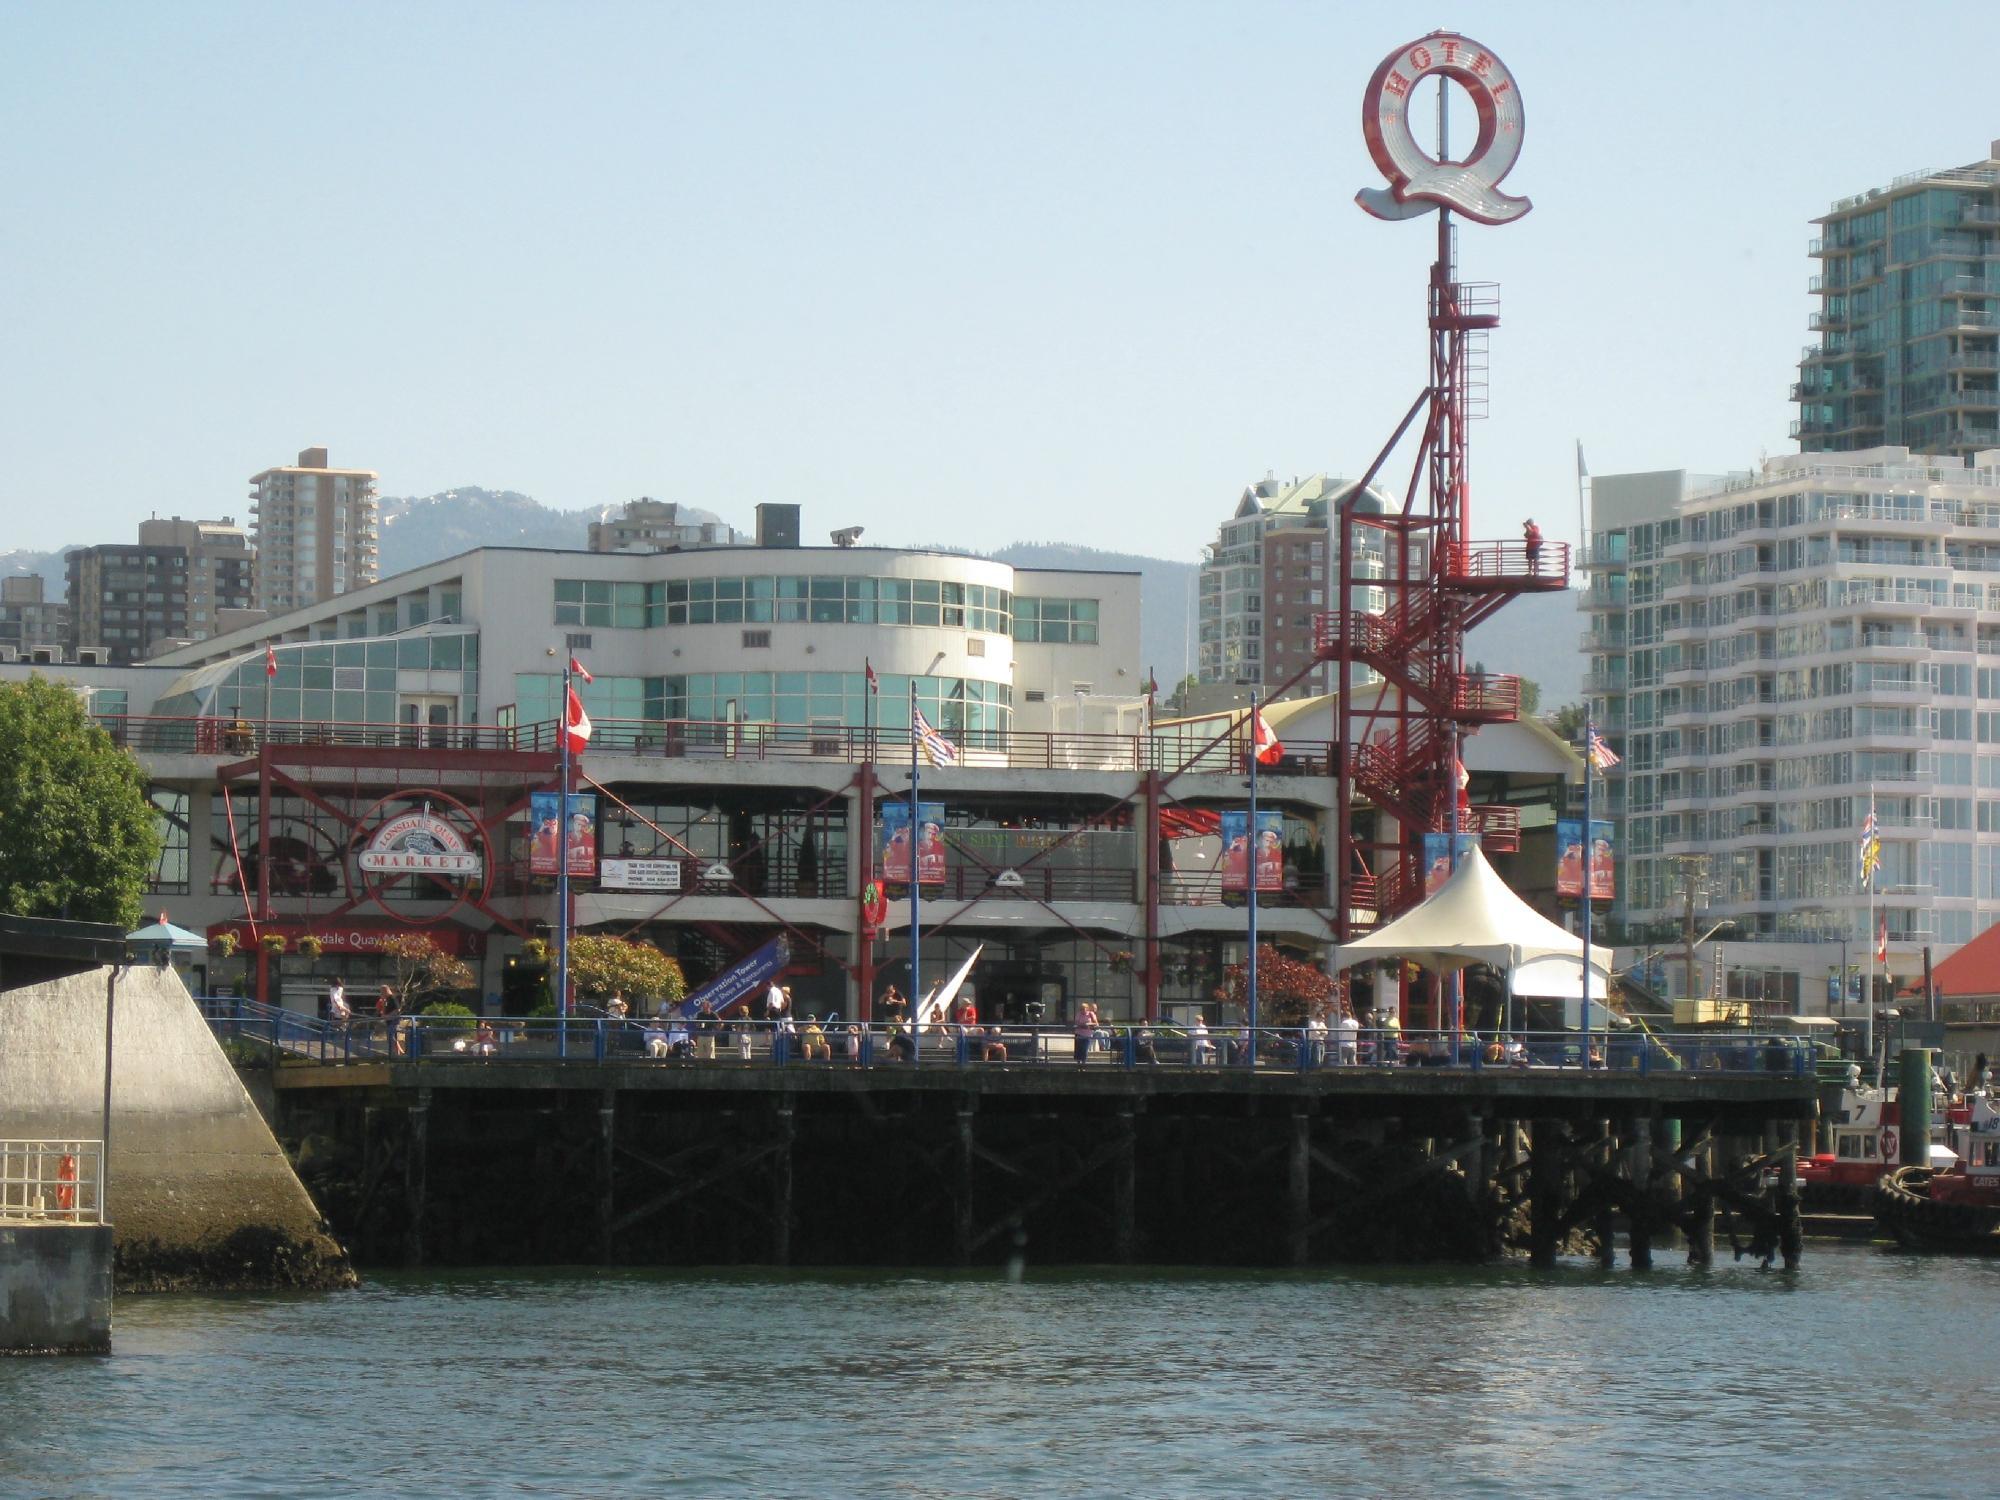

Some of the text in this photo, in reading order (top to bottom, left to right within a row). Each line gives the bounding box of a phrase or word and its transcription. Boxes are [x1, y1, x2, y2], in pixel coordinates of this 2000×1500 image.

[1384, 40, 1512, 105] HOTEL
[1354, 32, 1534, 226] Q
[379, 819, 460, 851] LONSDALE QUAY
[373, 855, 465, 868] MARKET
[349, 932, 380, 950] Quay
[693, 959, 758, 1007] Observation Tower
[1855, 1104, 1867, 1121] 7
[1972, 1175, 2000, 1187] CATES
